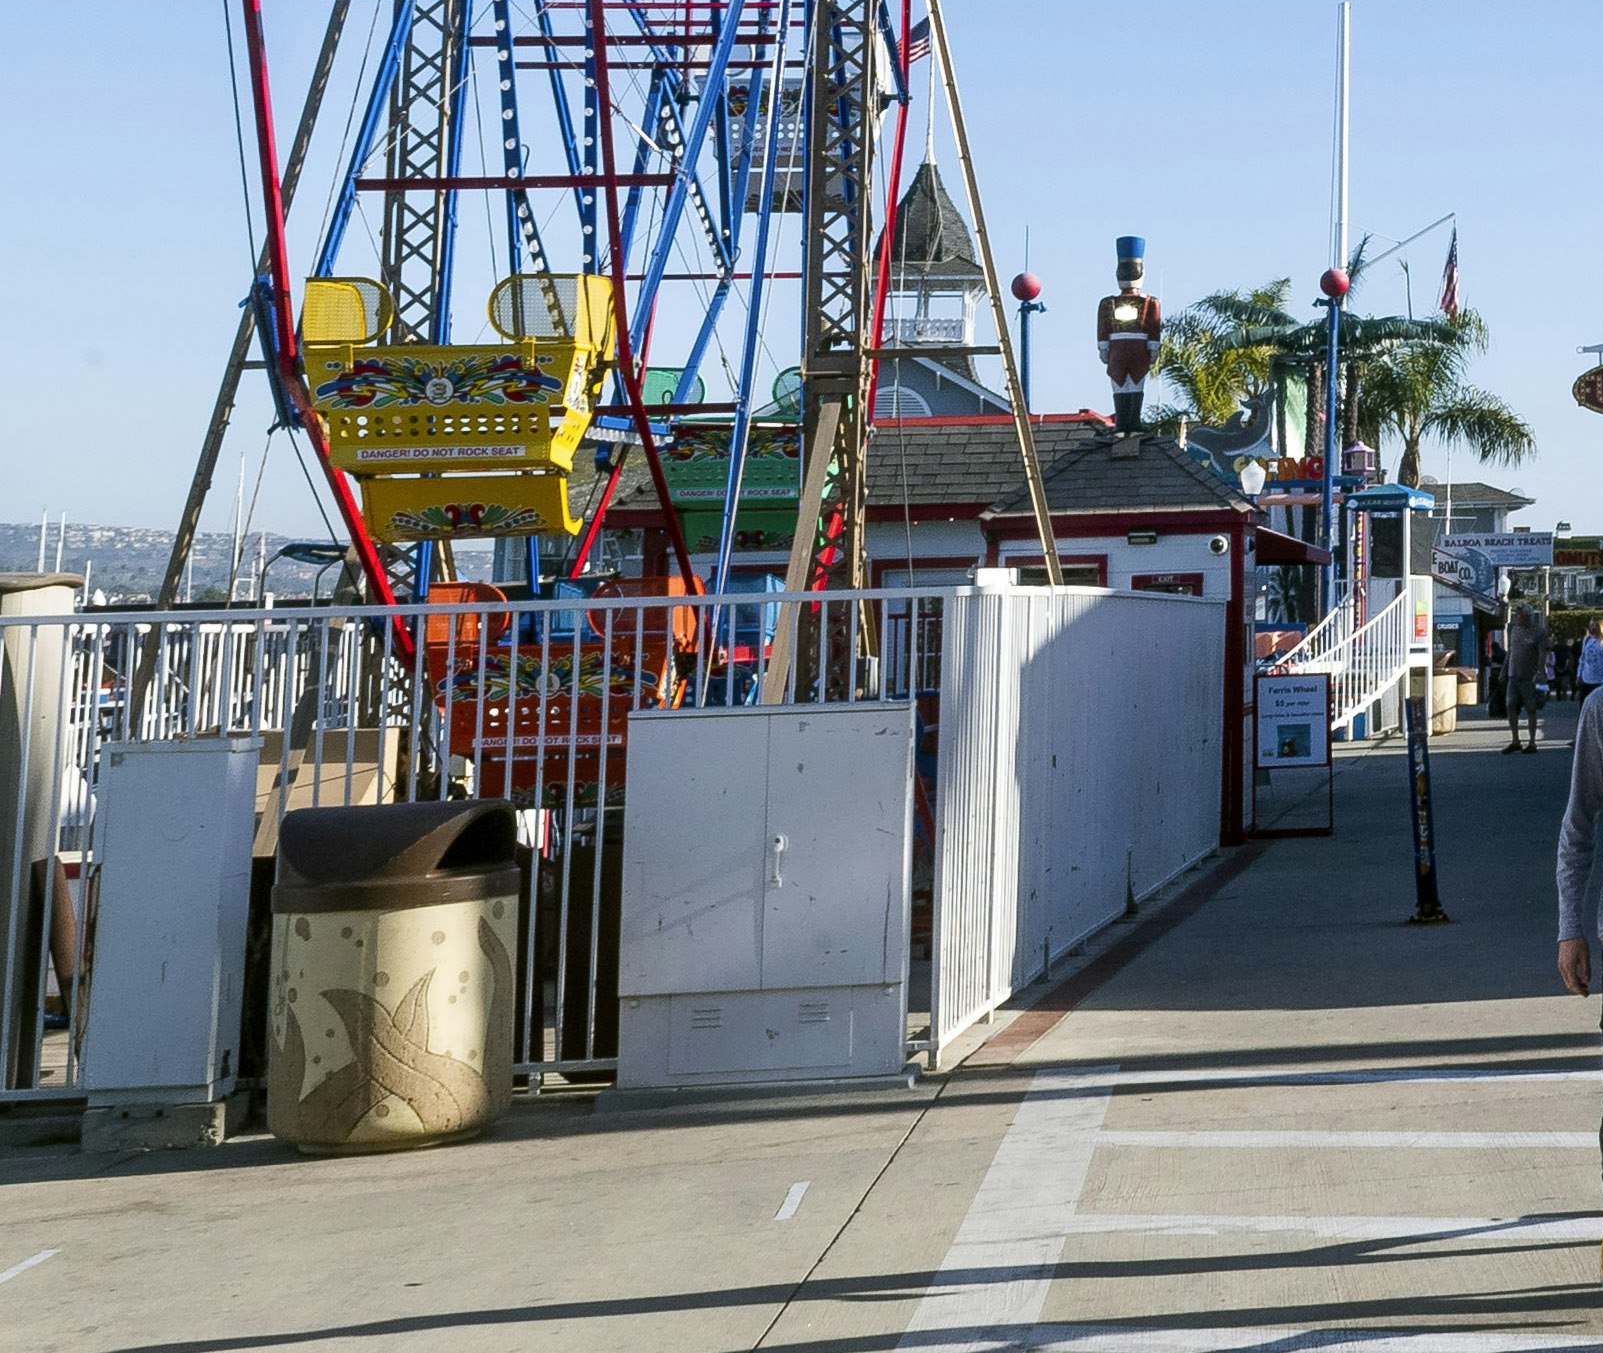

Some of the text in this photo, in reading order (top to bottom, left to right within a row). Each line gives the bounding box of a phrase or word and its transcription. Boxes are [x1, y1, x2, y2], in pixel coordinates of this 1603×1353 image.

[361, 447, 521, 459] DANGER! DO NOT ROCK SEAT
[1444, 536, 1552, 547] BALBOA BEACH TREATS
[1437, 560, 1459, 574] BOAT
[522, 736, 537, 746] DO
